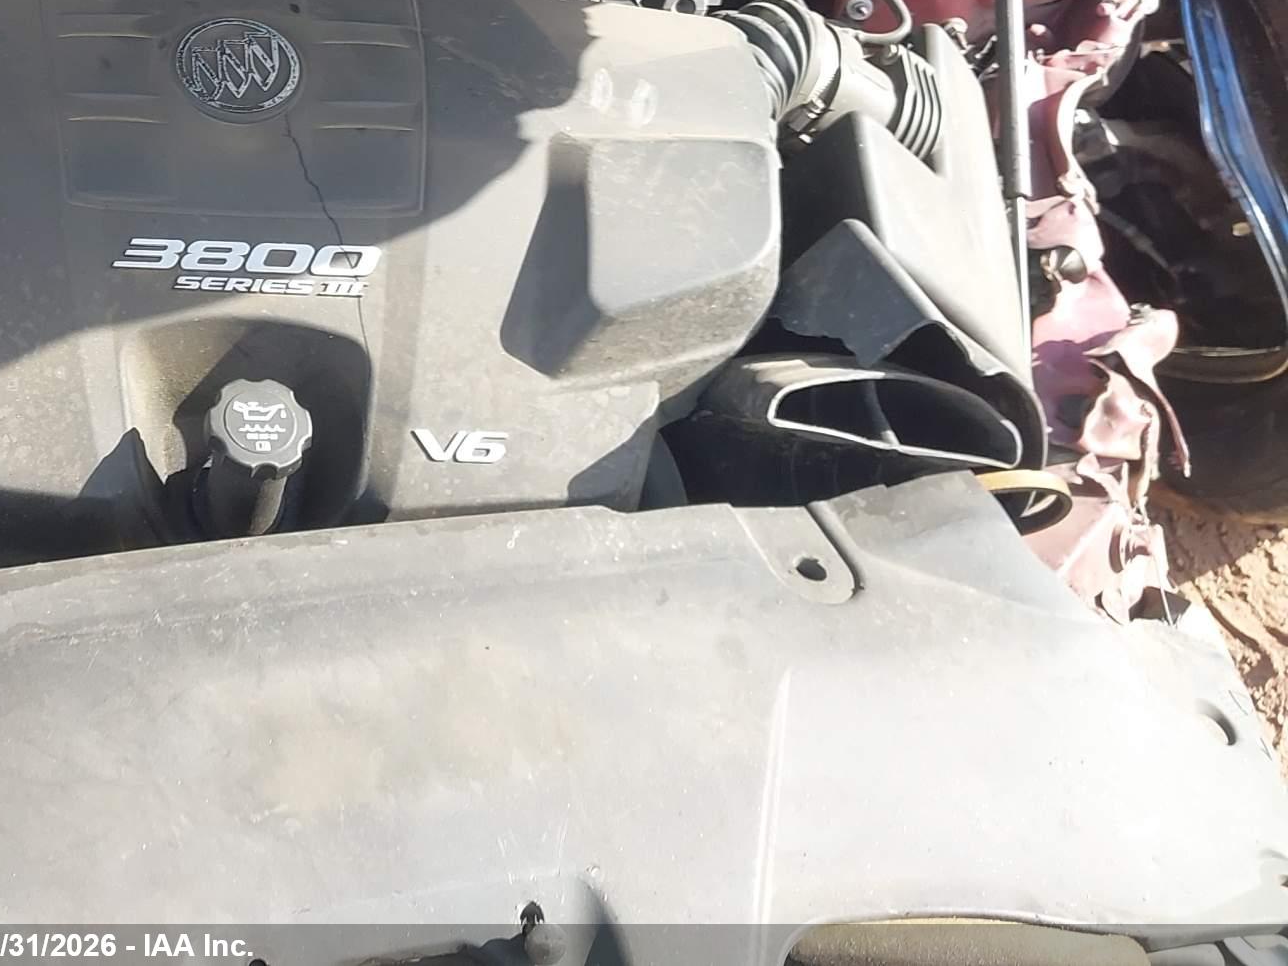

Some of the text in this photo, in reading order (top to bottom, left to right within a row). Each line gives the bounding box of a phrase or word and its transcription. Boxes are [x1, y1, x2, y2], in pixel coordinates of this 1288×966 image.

[112, 238, 382, 277] 3800
[174, 275, 369, 296] SERIES III
[410, 429, 509, 463] V6
